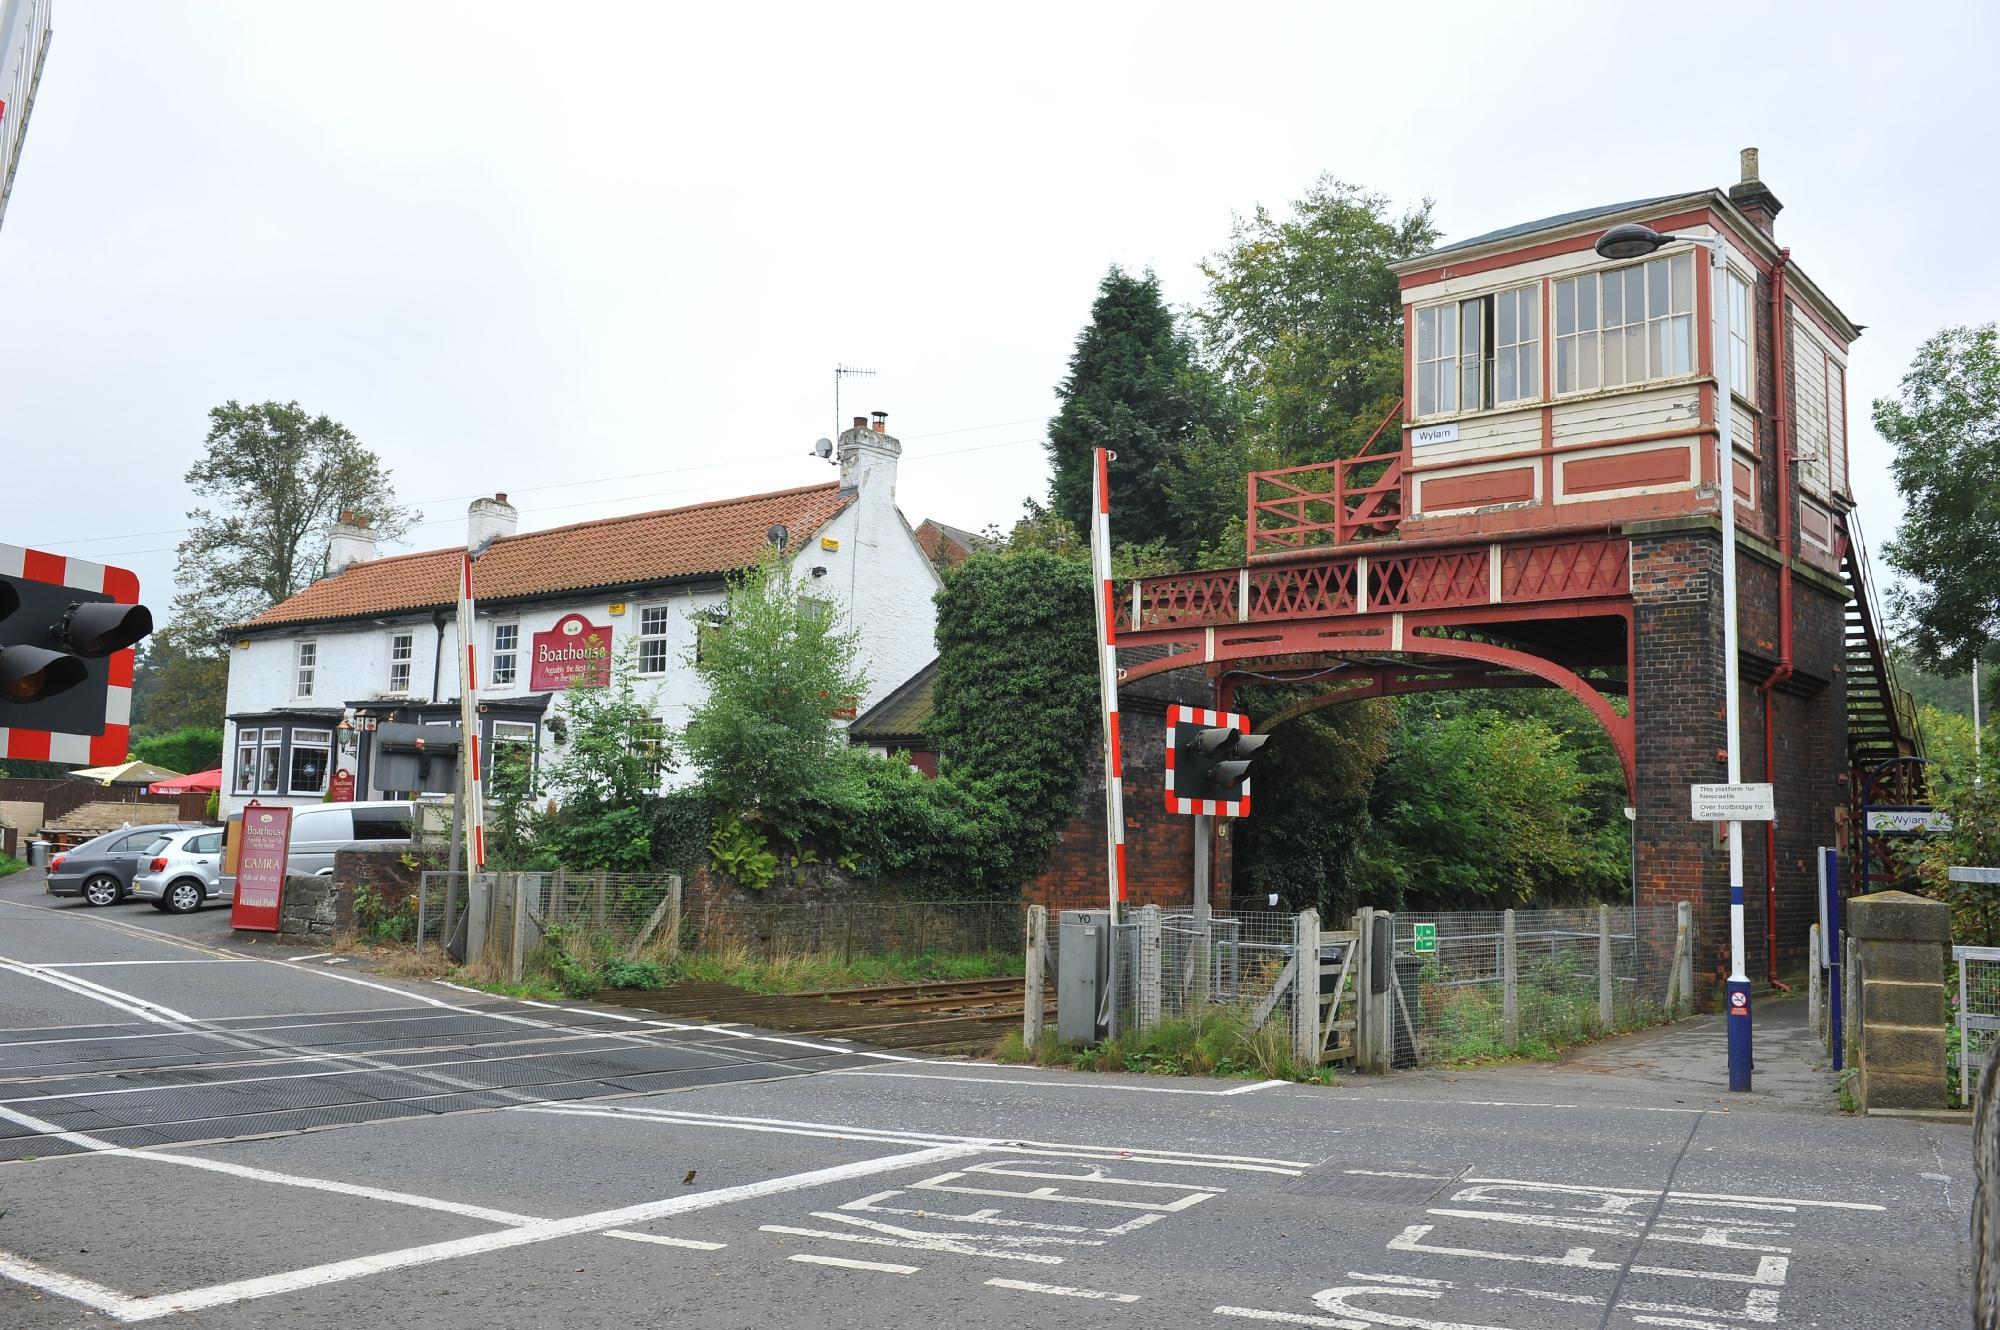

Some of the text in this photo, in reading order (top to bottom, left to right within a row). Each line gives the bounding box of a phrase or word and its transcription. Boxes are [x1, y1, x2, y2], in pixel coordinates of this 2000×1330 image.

[1419, 429, 1451, 441] Wylam
[538, 642, 606, 663] Boathouse
[544, 665, 564, 676] Arguably
[566, 664, 574, 673] the
[1718, 803, 1753, 811] footbridge
[1892, 815, 1928, 826] Wylam
[247, 824, 286, 836] Boathouse
[244, 857, 280, 870] CAMRA
[1077, 913, 1091, 924] YO
[758, 1159, 1227, 1265] KEEP
